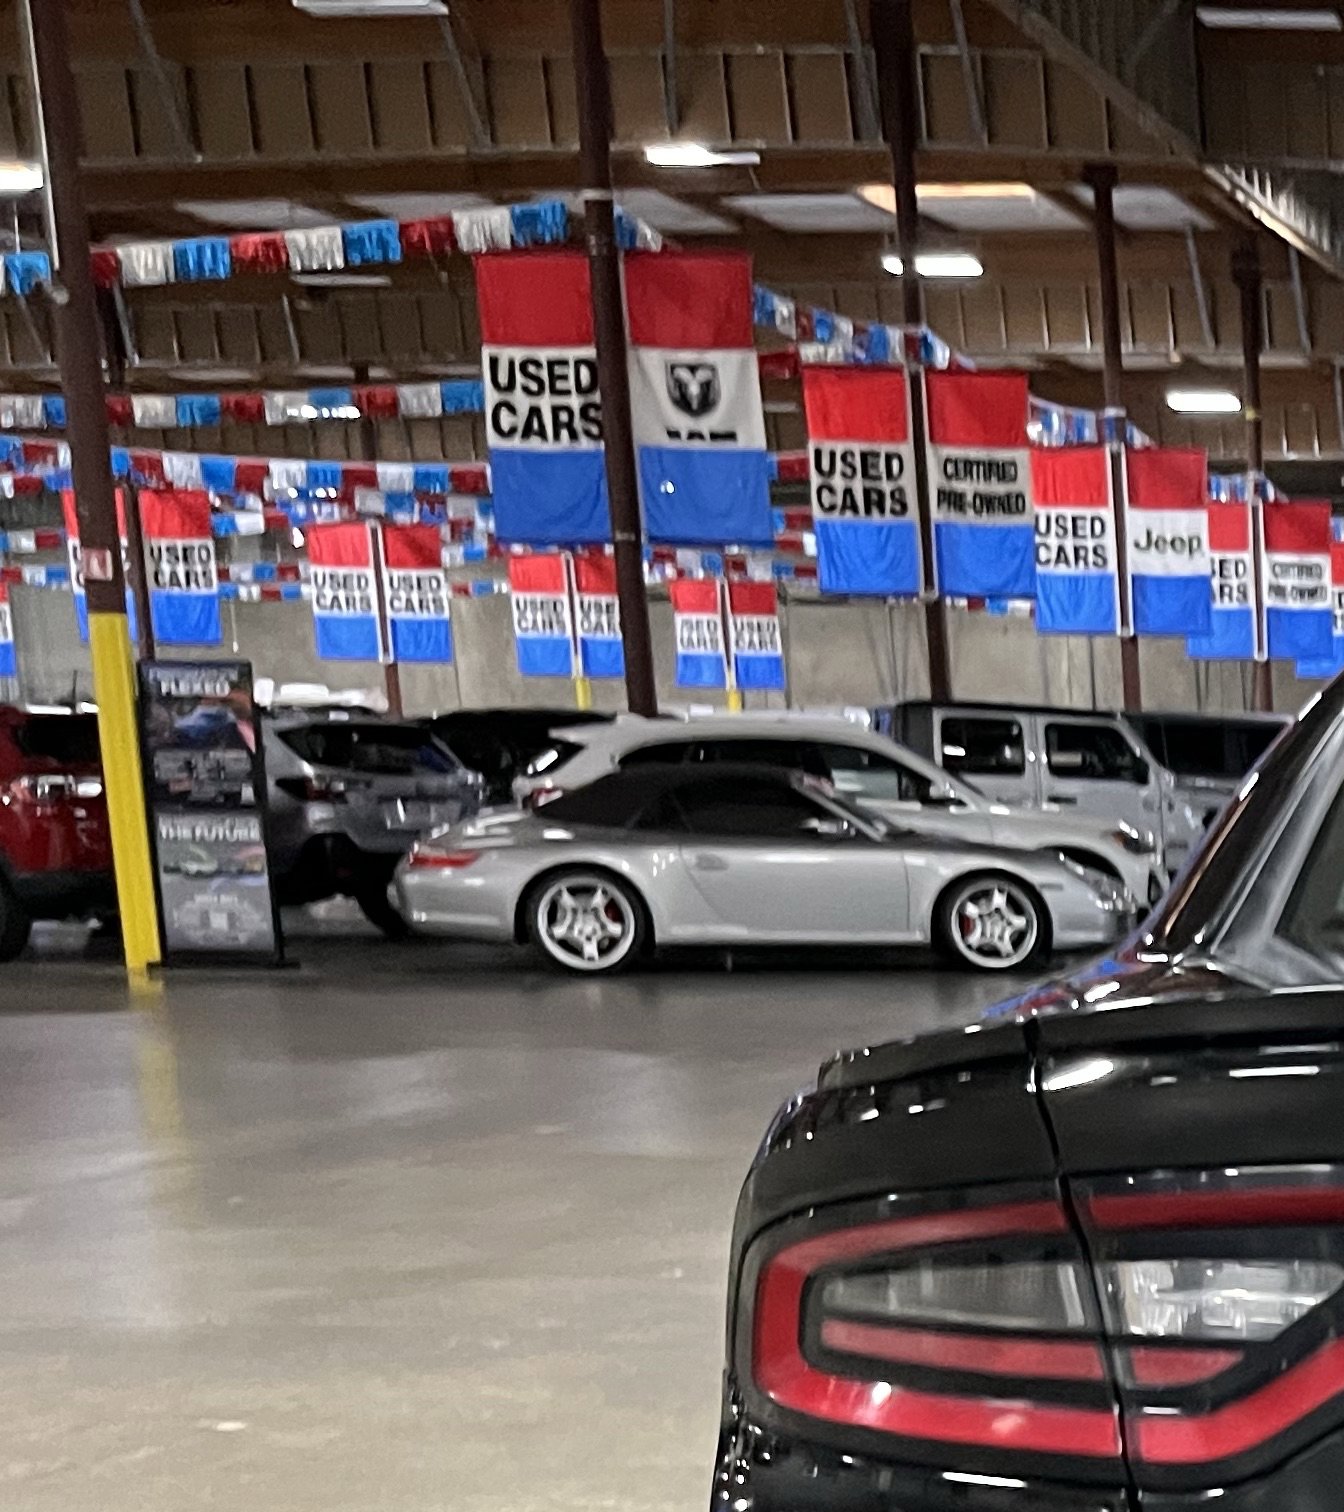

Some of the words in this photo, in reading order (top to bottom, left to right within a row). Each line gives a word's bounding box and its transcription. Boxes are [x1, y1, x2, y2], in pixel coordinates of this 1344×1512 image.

[488, 356, 599, 396] USED
[491, 400, 602, 441] CARS
[813, 448, 904, 481] USED
[943, 457, 1018, 483] CERTIFIED
[816, 484, 908, 516] CARS
[936, 488, 1027, 515] PRE-OWNED
[1035, 514, 1106, 539] USED
[1035, 542, 1108, 569] CARS
[1133, 528, 1203, 558] Jeep
[313, 571, 369, 591] USED
[389, 574, 442, 592] USED
[315, 591, 373, 611] CARS
[389, 594, 446, 614] CARS
[580, 599, 617, 615] USE
[581, 617, 618, 635] CAR
